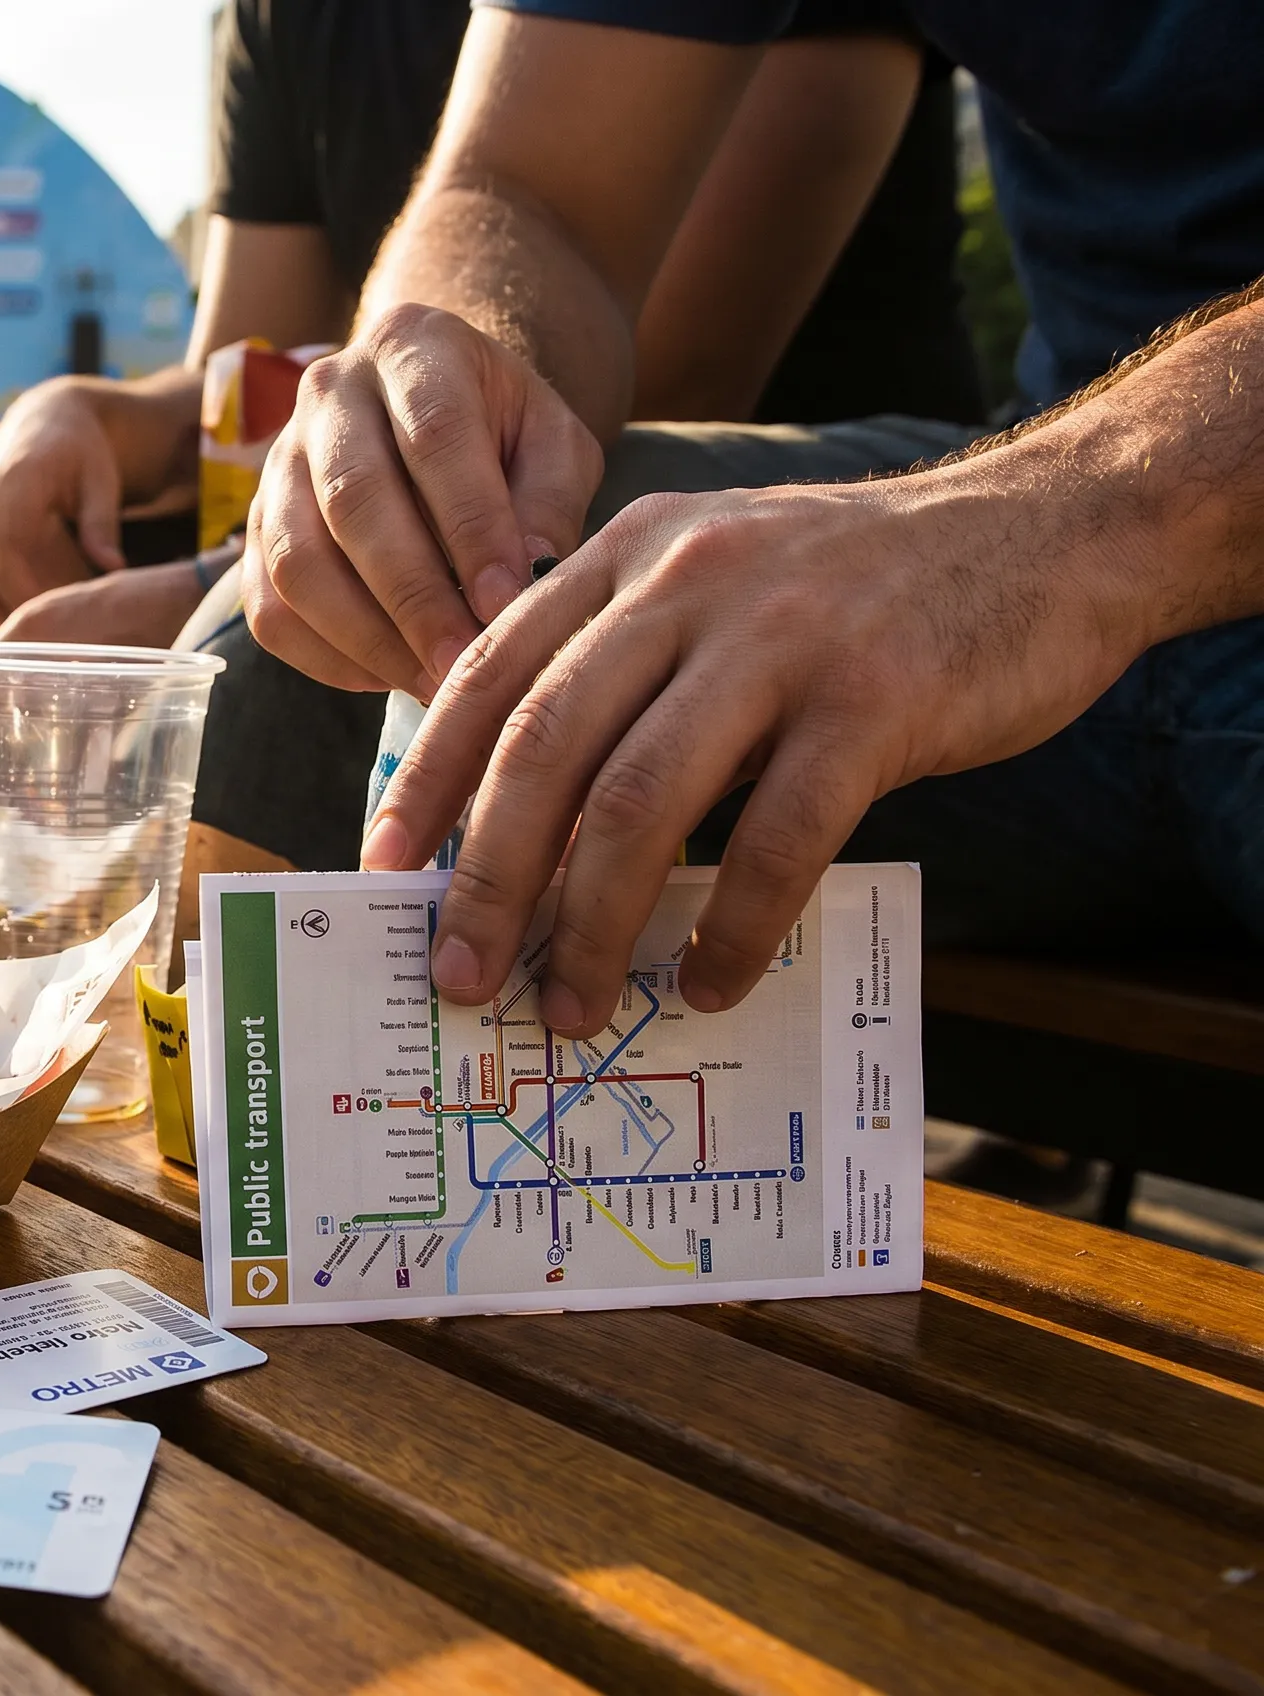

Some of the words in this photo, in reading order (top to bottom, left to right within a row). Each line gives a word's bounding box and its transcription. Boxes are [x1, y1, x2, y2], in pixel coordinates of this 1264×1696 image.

[240, 1015, 272, 1150] transport
[242, 1159, 272, 1246] Public
[32, 1364, 153, 1402] METRO
